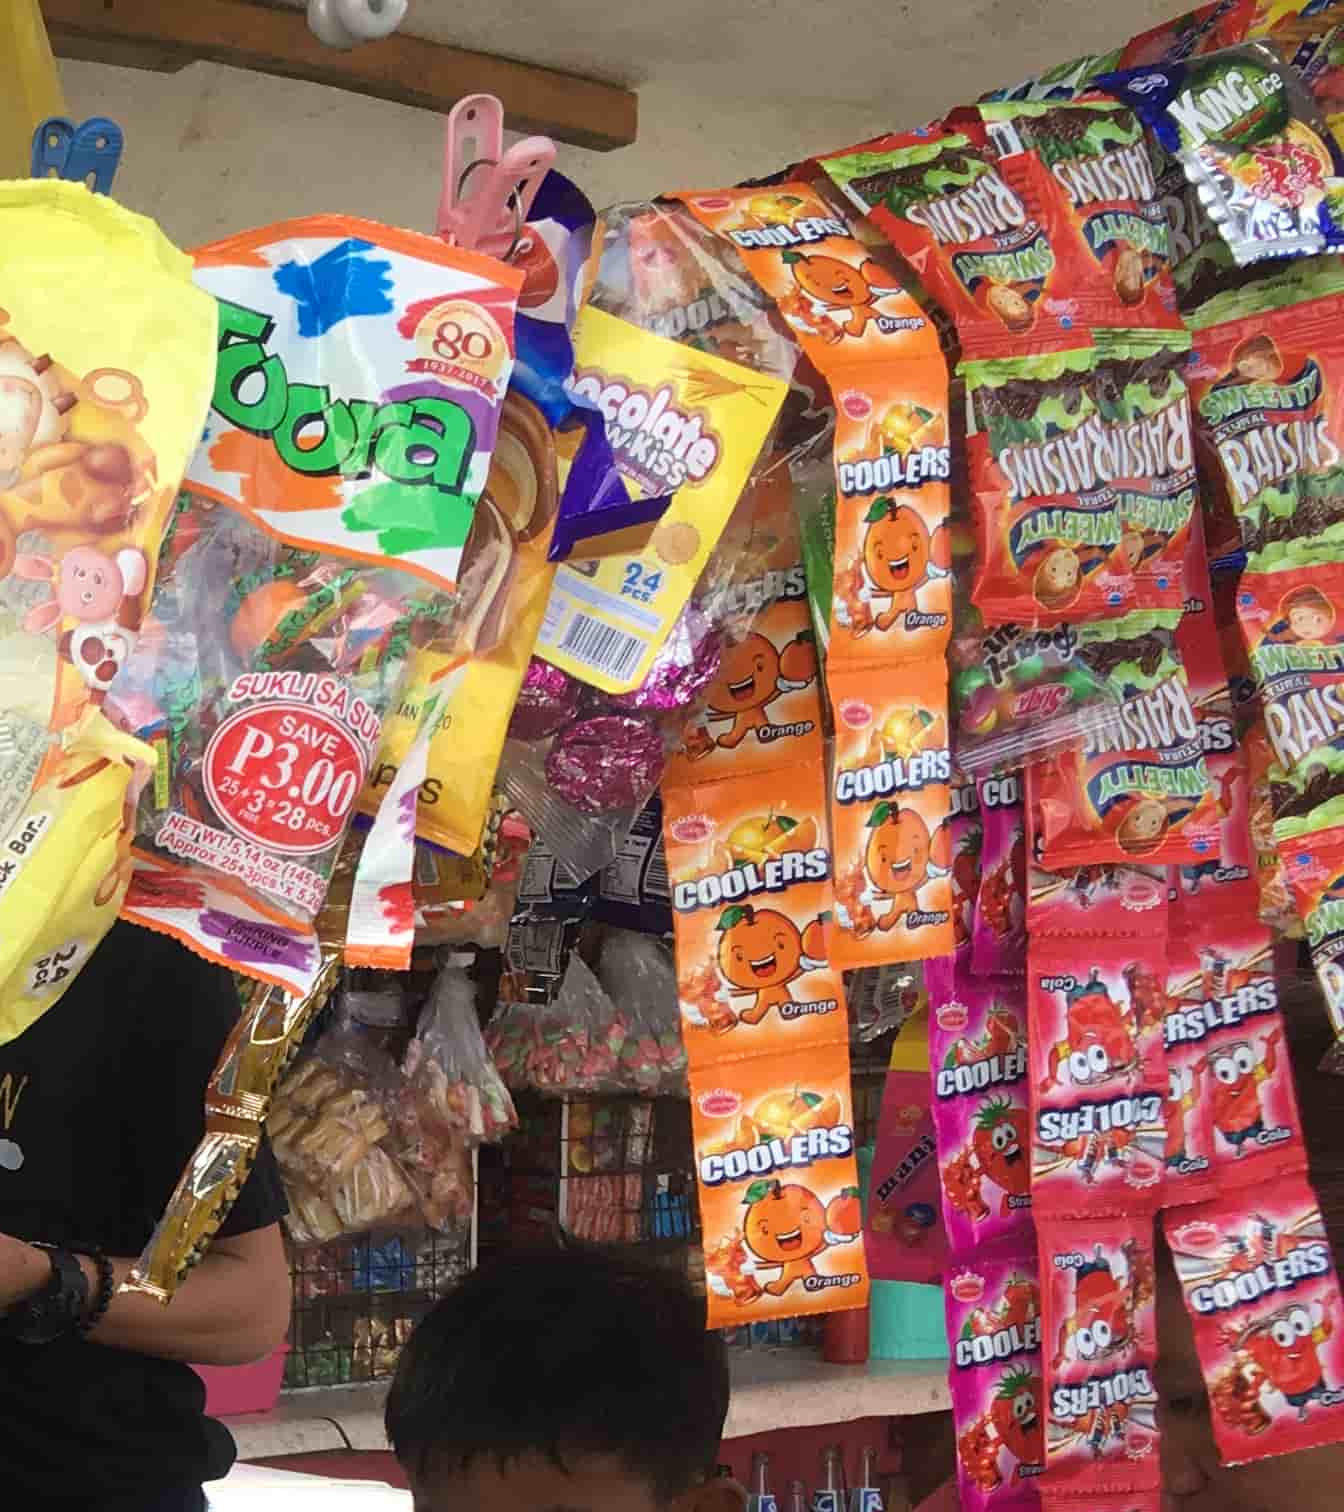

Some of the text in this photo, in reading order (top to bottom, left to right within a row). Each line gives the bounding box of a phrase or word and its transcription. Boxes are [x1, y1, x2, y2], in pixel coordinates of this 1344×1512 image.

[1167, 71, 1259, 148] KING
[734, 216, 848, 250] COOLERS
[839, 446, 950, 494] COOLERS
[624, 562, 662, 592] 24
[230, 672, 313, 702] SUKLI
[315, 679, 348, 715] SA
[279, 715, 341, 757] SAVE
[226, 726, 358, 818] P3.00
[835, 751, 951, 801] COOLERS
[168, 815, 200, 838] NET
[263, 852, 283, 873] oz
[672, 848, 829, 912] COOLERS
[1214, 865, 1249, 882] Cola
[1040, 975, 1076, 992] Cola
[780, 998, 838, 1018] Orange
[1039, 1095, 1162, 1140] COOLERS
[1256, 1127, 1291, 1146] Cola
[698, 1124, 852, 1185] COOLERS
[804, 1272, 861, 1291] Orange
[1052, 1252, 1085, 1268] Cola
[1191, 1246, 1330, 1315] COOLERS
[1051, 1367, 1154, 1418] COOLERS
